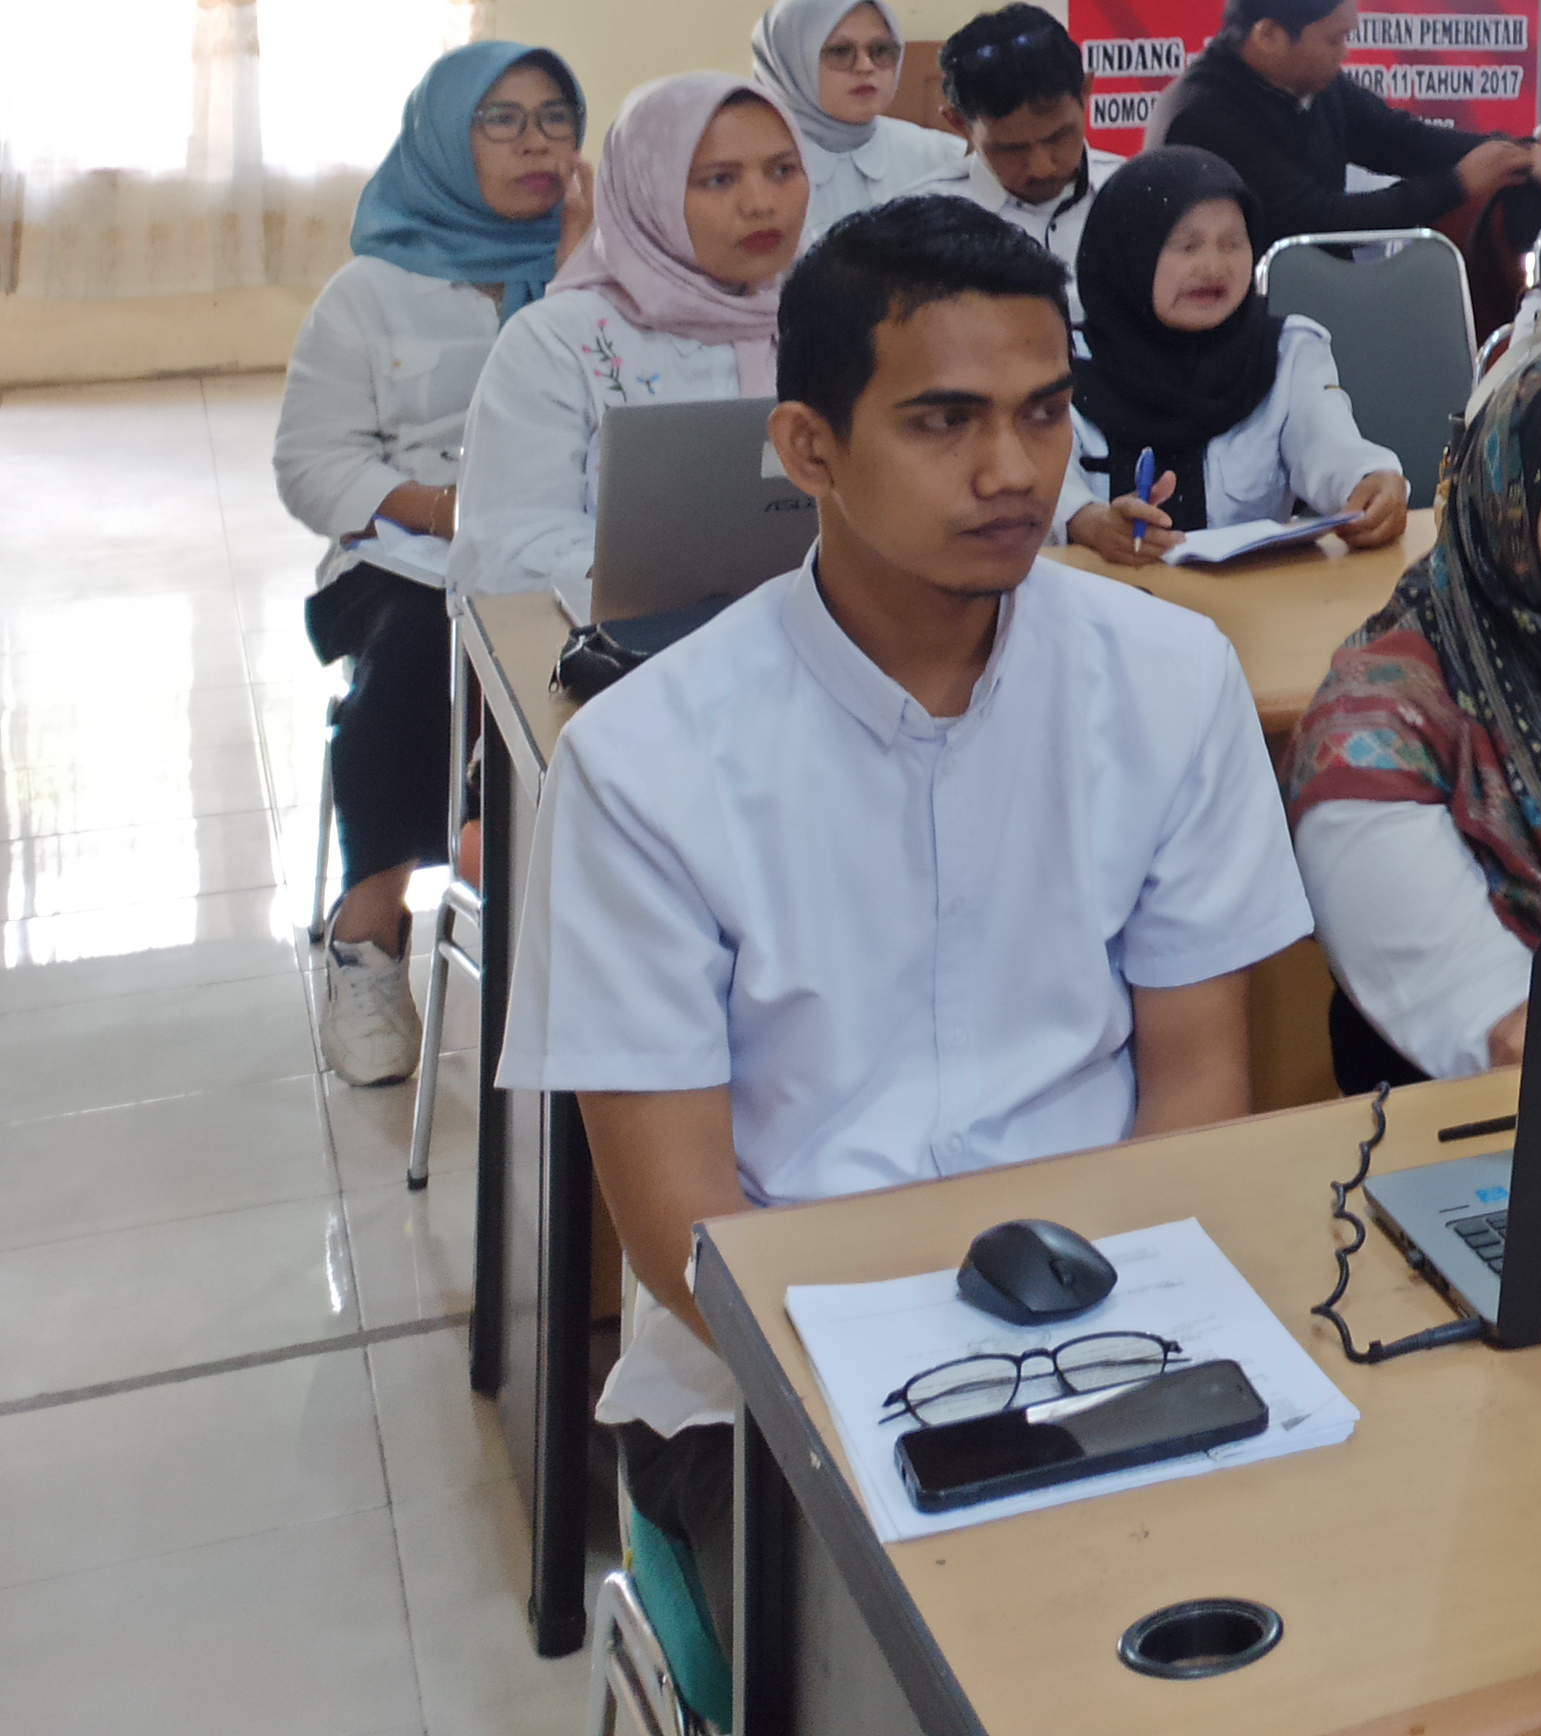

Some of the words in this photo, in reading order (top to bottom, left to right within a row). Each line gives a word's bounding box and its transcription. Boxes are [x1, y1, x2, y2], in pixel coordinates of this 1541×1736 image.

[1346, 18, 1414, 46] ATURAN
[1420, 19, 1524, 46] PEMERINTAH
[1087, 42, 1181, 72] UNDANG
[1392, 70, 1408, 94] 11
[1416, 70, 1475, 94] TAHUN
[1481, 70, 1520, 94] 2017
[1094, 97, 1156, 124] NOMO
